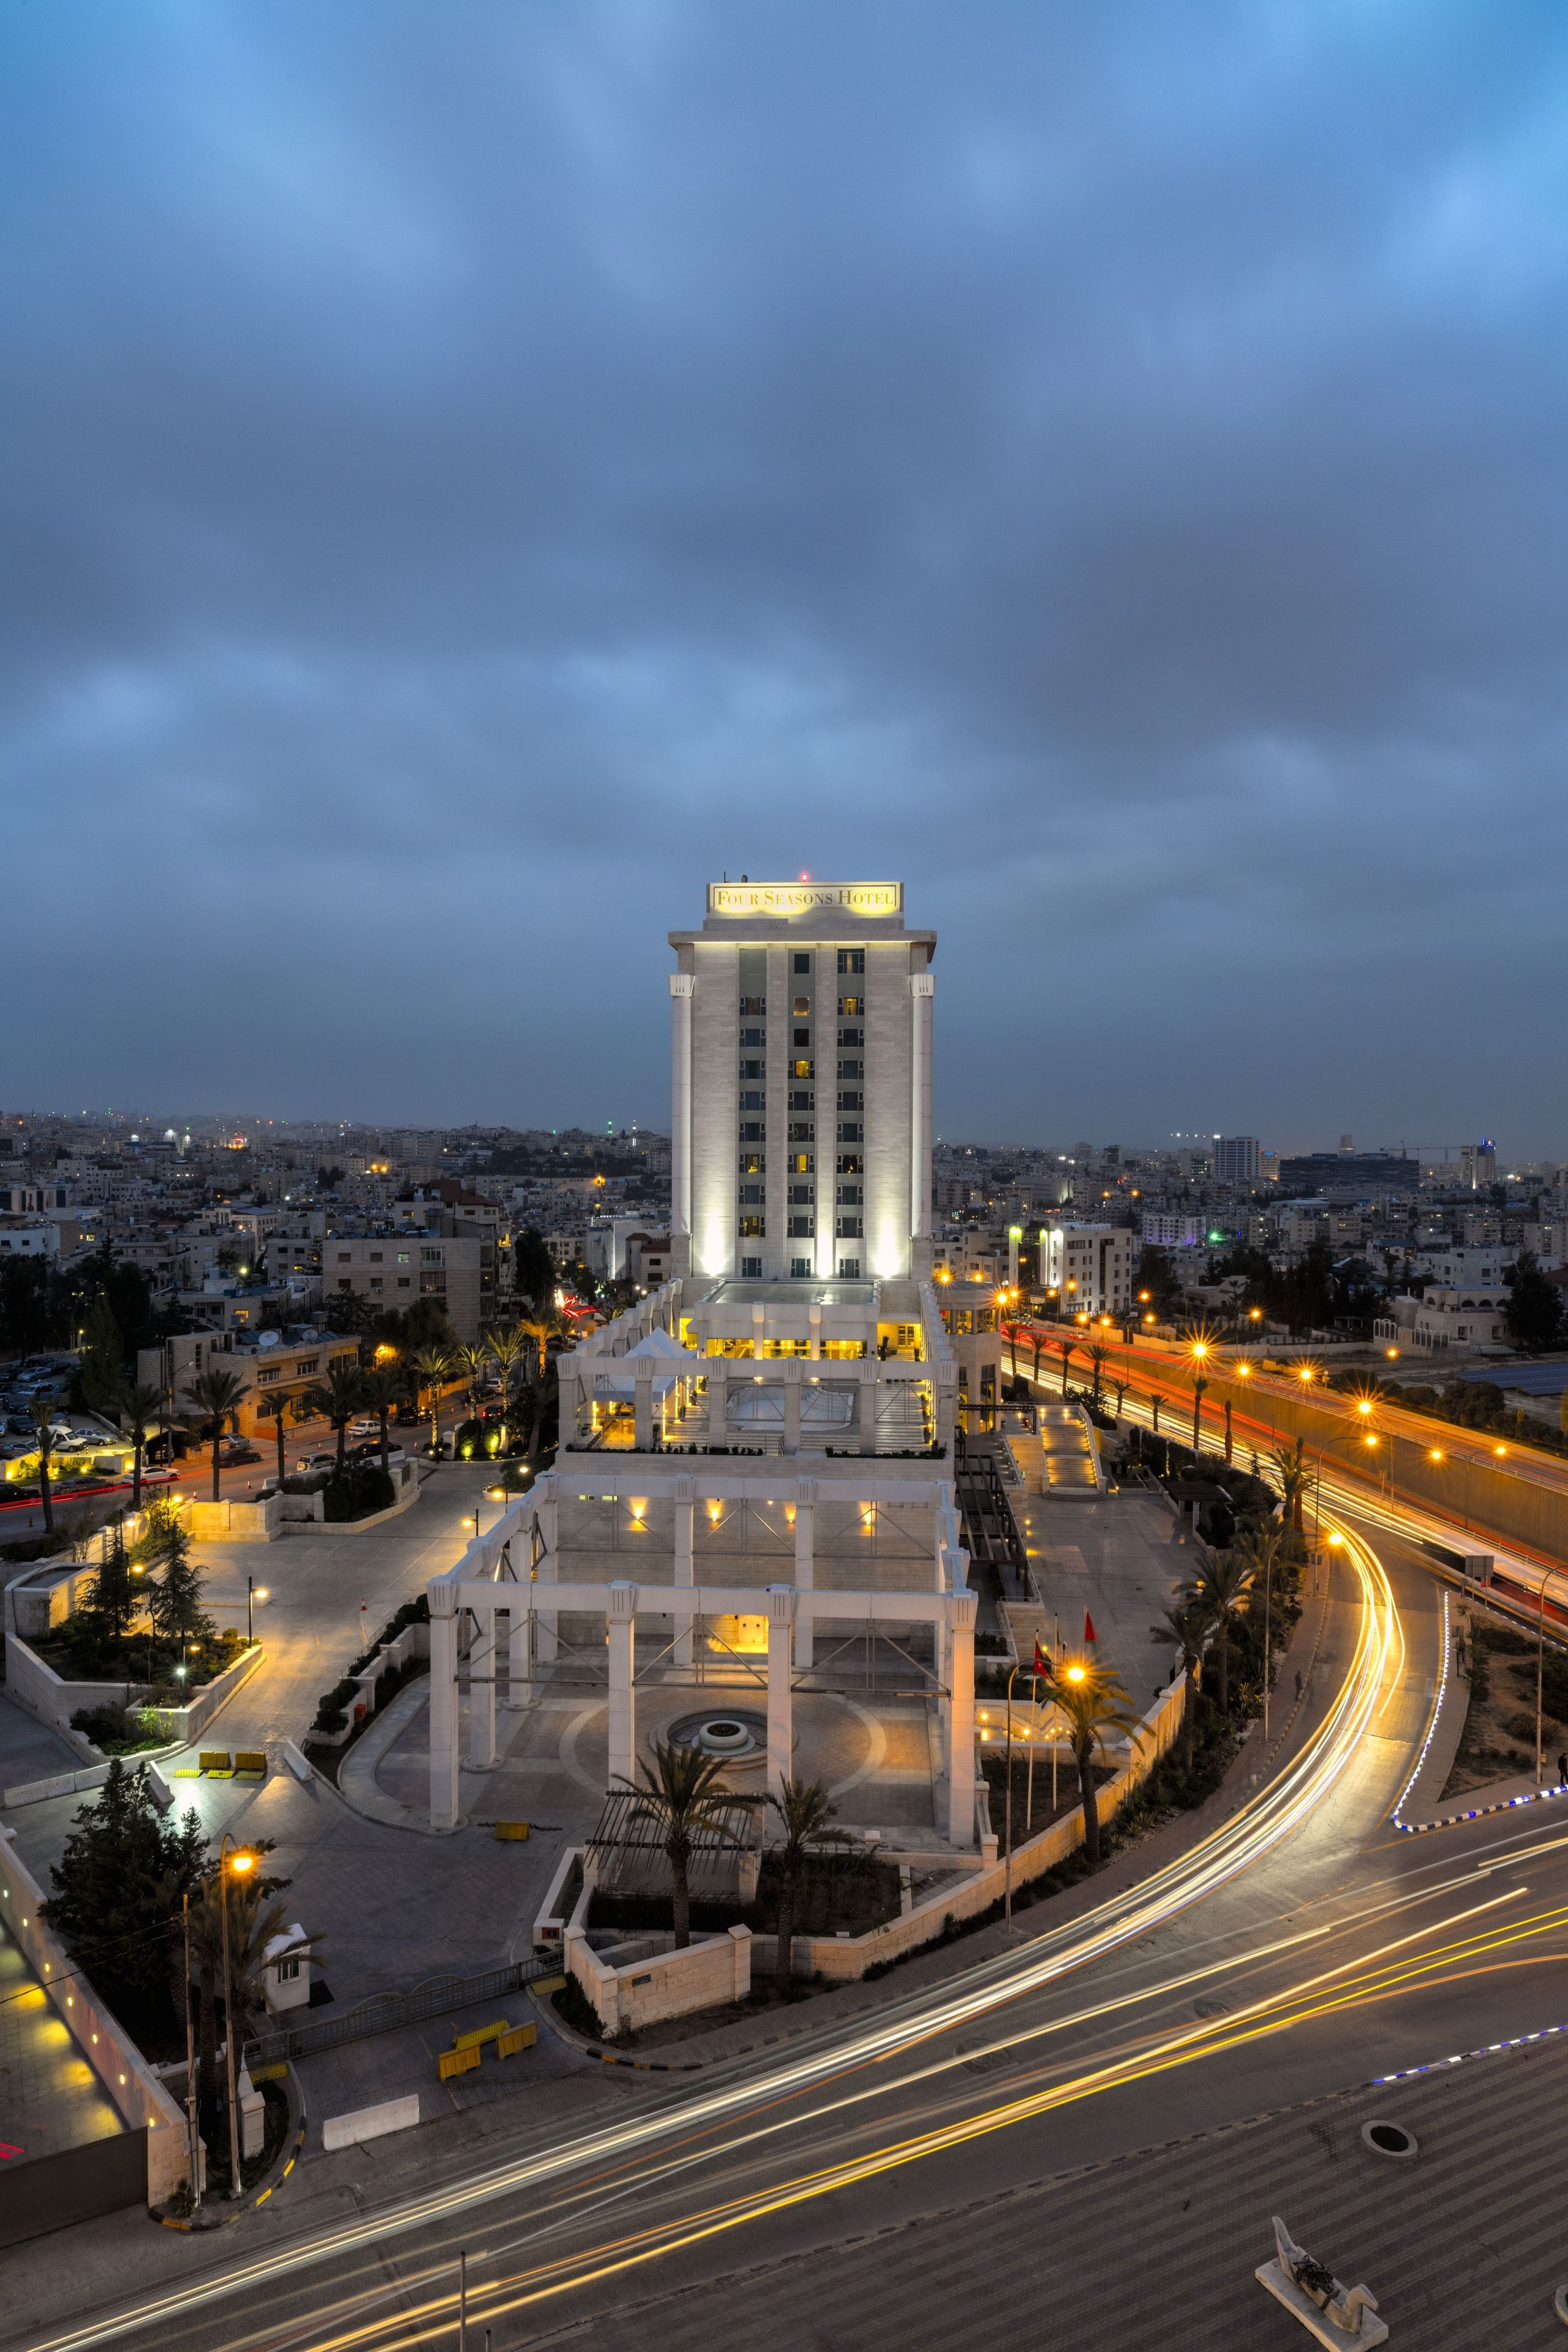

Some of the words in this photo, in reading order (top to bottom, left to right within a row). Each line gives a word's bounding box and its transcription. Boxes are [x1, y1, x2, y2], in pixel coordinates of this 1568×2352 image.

[716, 891, 758, 905] FOUR
[764, 891, 832, 905] SEASONS
[837, 890, 893, 905] HOTEL
